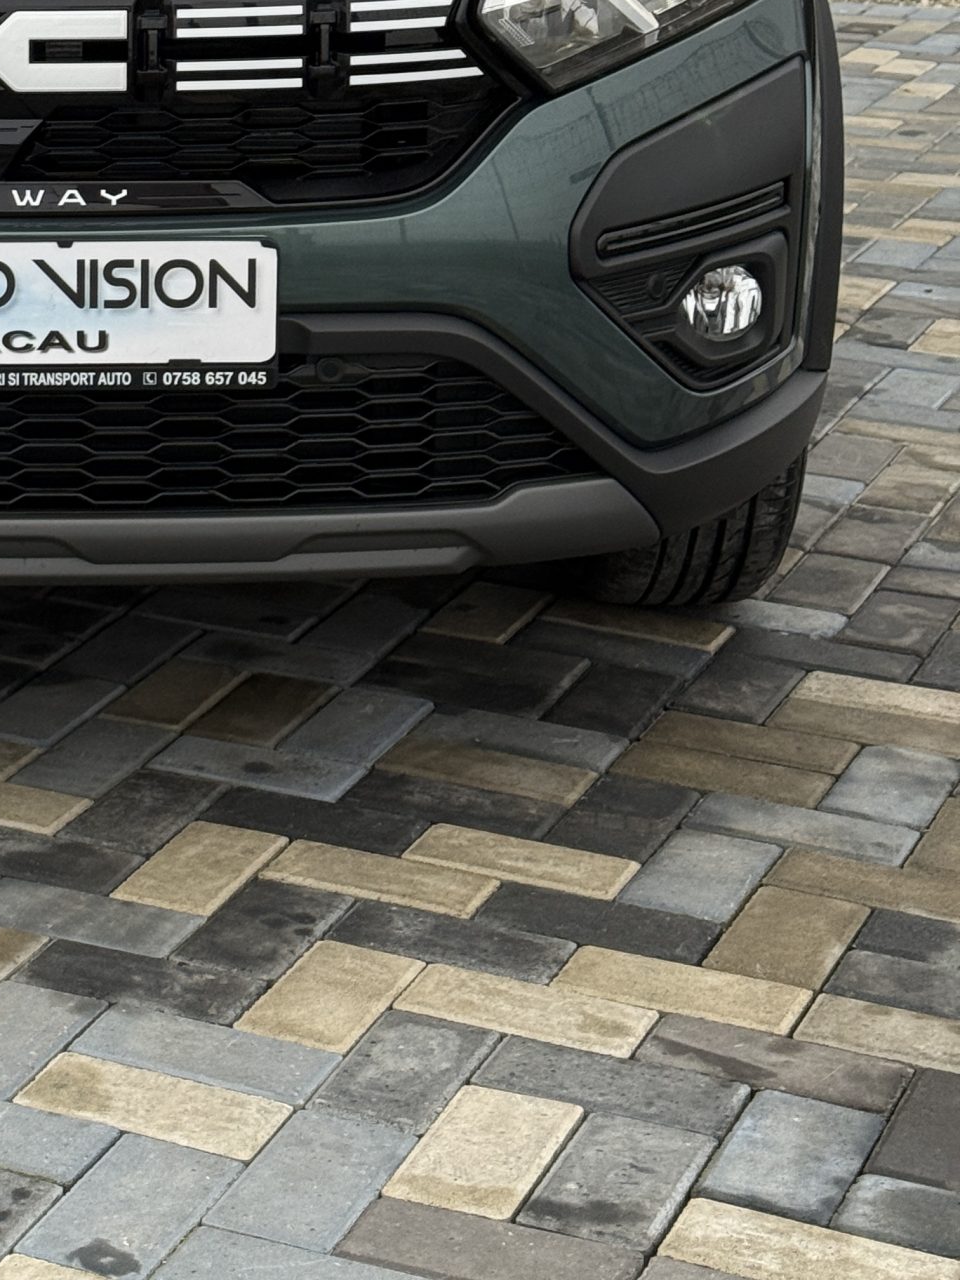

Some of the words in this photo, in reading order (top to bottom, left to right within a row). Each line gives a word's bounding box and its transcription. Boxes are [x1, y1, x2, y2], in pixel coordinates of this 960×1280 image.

[31, 258, 257, 309] VISION
[7, 372, 20, 386] SI
[22, 372, 96, 386] TRANSPORT
[98, 372, 132, 386] AUTO
[162, 372, 201, 385] 0758
[204, 372, 234, 385] 657
[238, 371, 267, 385] 045
